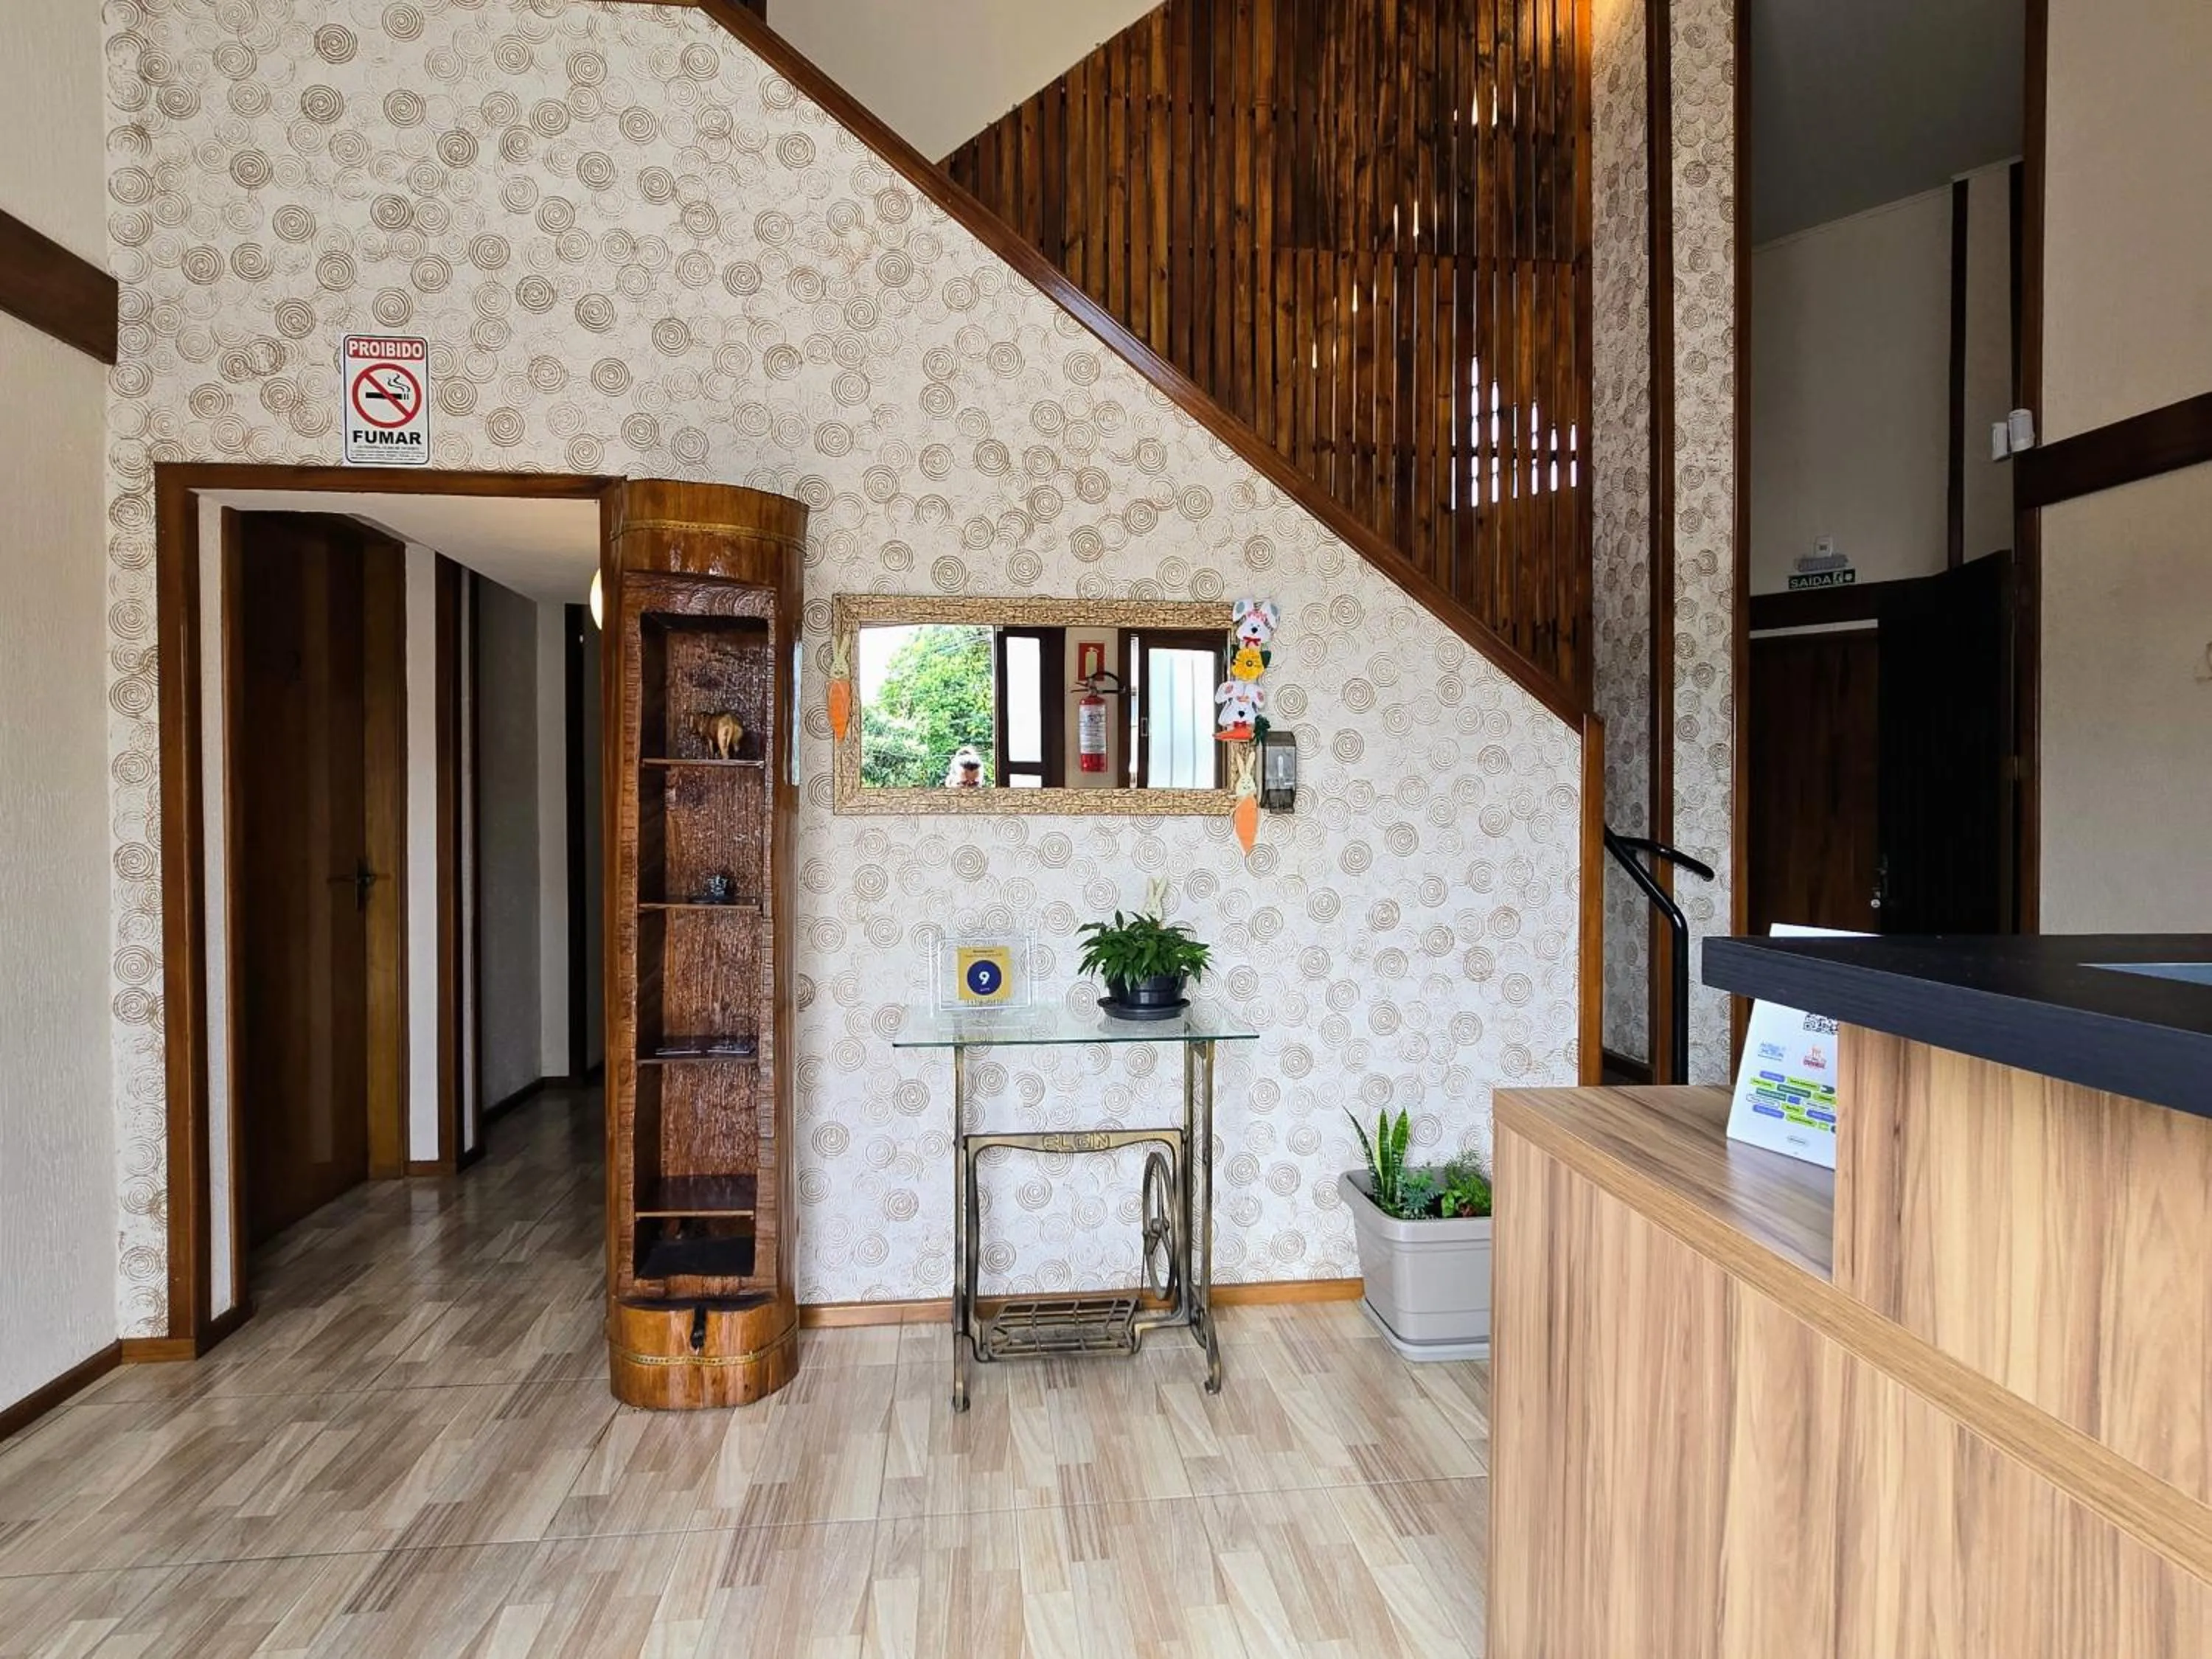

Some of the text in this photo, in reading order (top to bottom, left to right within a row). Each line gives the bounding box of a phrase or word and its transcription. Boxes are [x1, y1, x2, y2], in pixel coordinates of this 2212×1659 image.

[349, 341, 422, 358] PROIBIDO
[352, 431, 422, 445] FUMAR
[978, 971, 990, 985] 9
[1043, 1133, 1112, 1150] ELGIN
